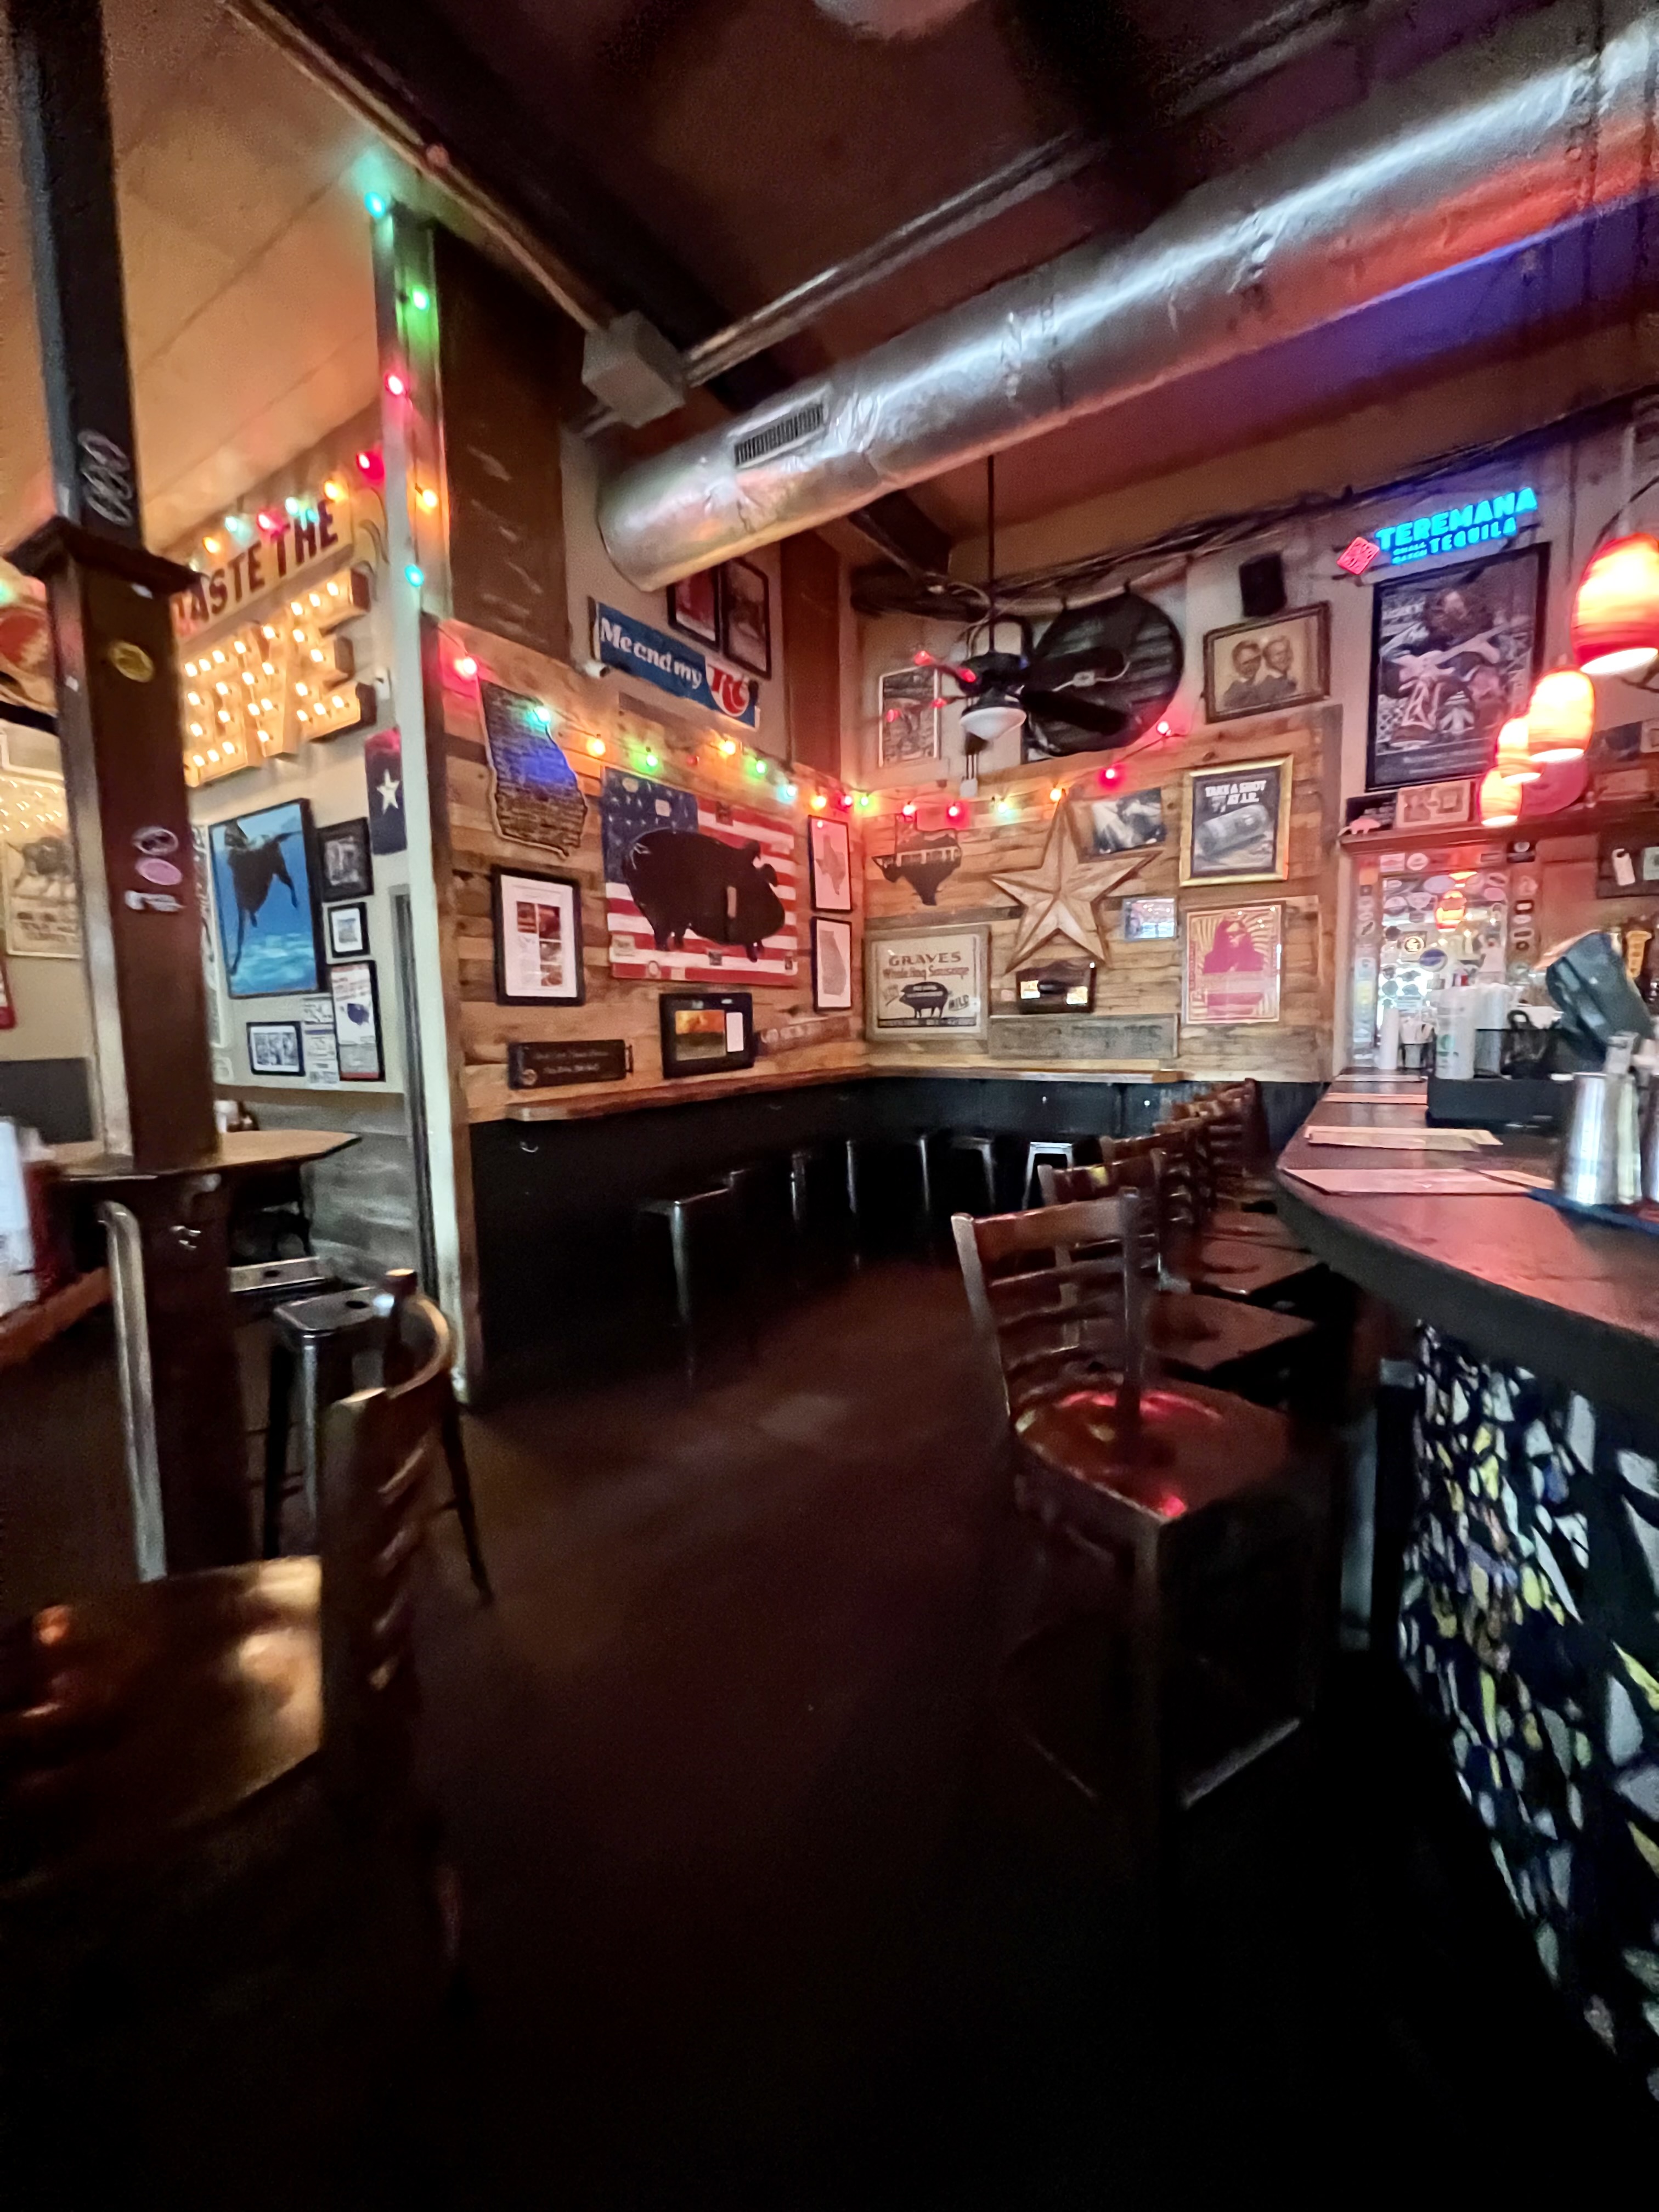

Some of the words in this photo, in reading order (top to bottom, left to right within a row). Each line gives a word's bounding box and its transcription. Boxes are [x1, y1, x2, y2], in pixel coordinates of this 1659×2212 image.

[270, 499, 338, 578] THE
[1375, 487, 1537, 550] TEREMANA
[1429, 517, 1517, 554] TEQUILA
[601, 617, 633, 653] Me
[674, 661, 703, 690] my
[888, 951, 961, 966] GRAVES
